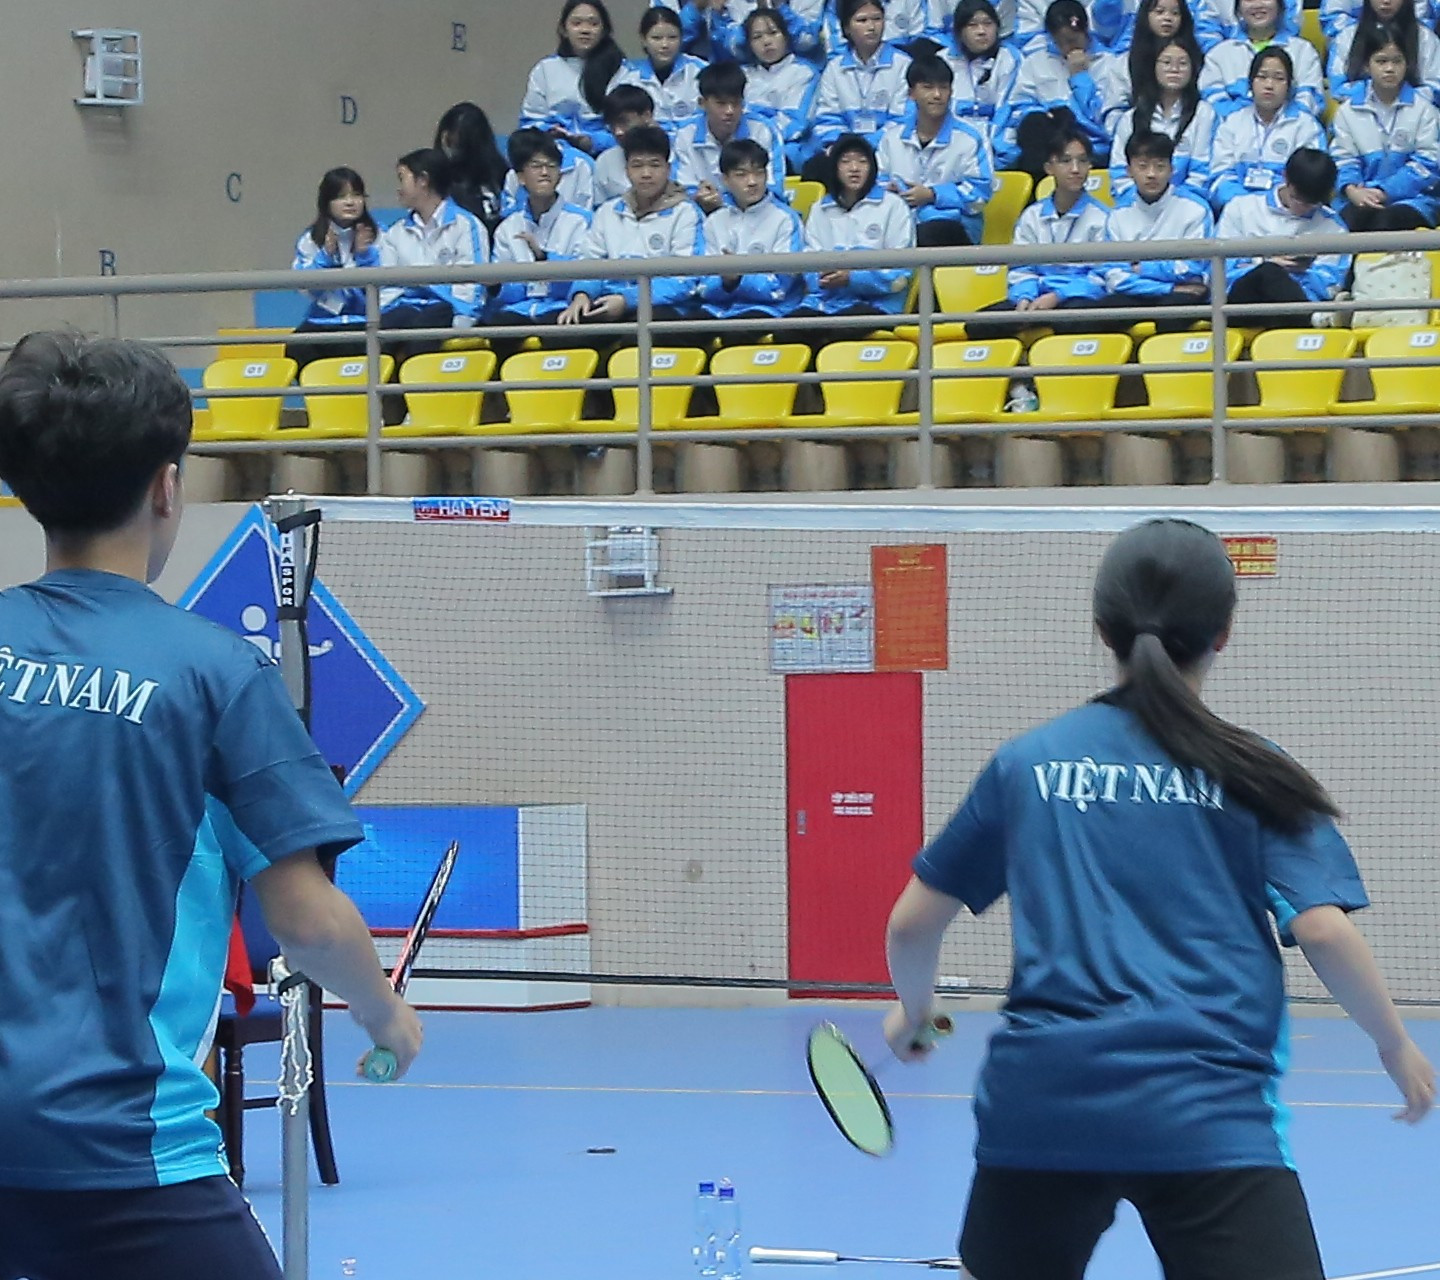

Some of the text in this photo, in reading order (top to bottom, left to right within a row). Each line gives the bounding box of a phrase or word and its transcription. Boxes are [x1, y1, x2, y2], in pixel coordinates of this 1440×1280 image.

[451, 21, 466, 52] E
[340, 95, 358, 124] D
[226, 172, 242, 202] C
[282, 535, 293, 606] IFASPOR
[39, 662, 160, 725] NAM
[1031, 755, 1225, 814] VIỆT NAM
